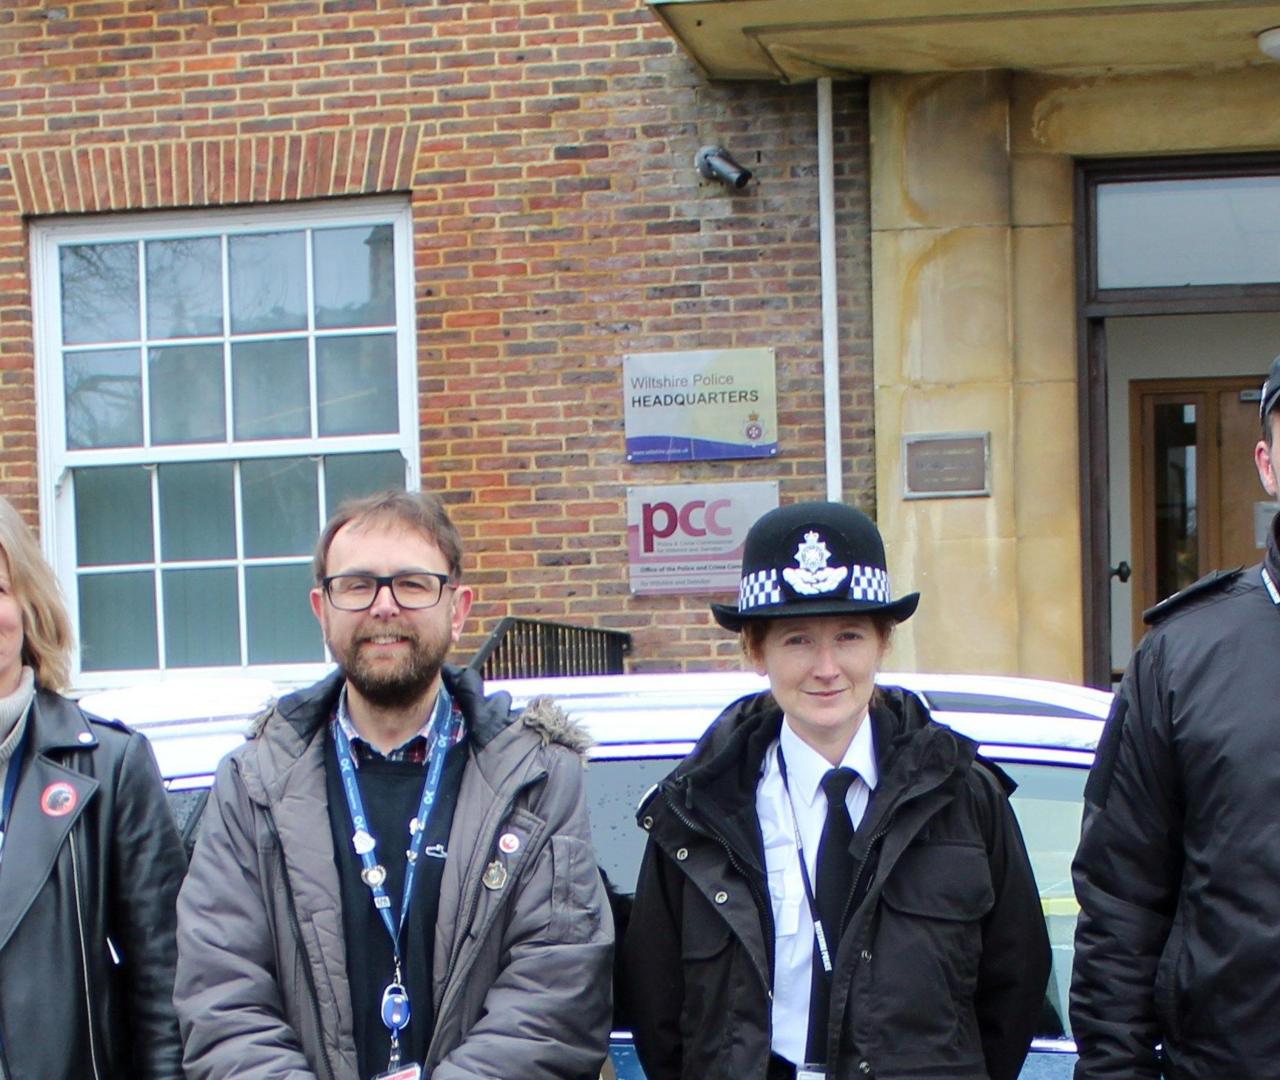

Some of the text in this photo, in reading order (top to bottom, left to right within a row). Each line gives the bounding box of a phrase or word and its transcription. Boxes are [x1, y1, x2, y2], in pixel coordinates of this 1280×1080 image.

[631, 373, 734, 390] Wiltshire Police
[631, 390, 759, 408] HEADQUARTERS
[642, 499, 732, 553] pcc
